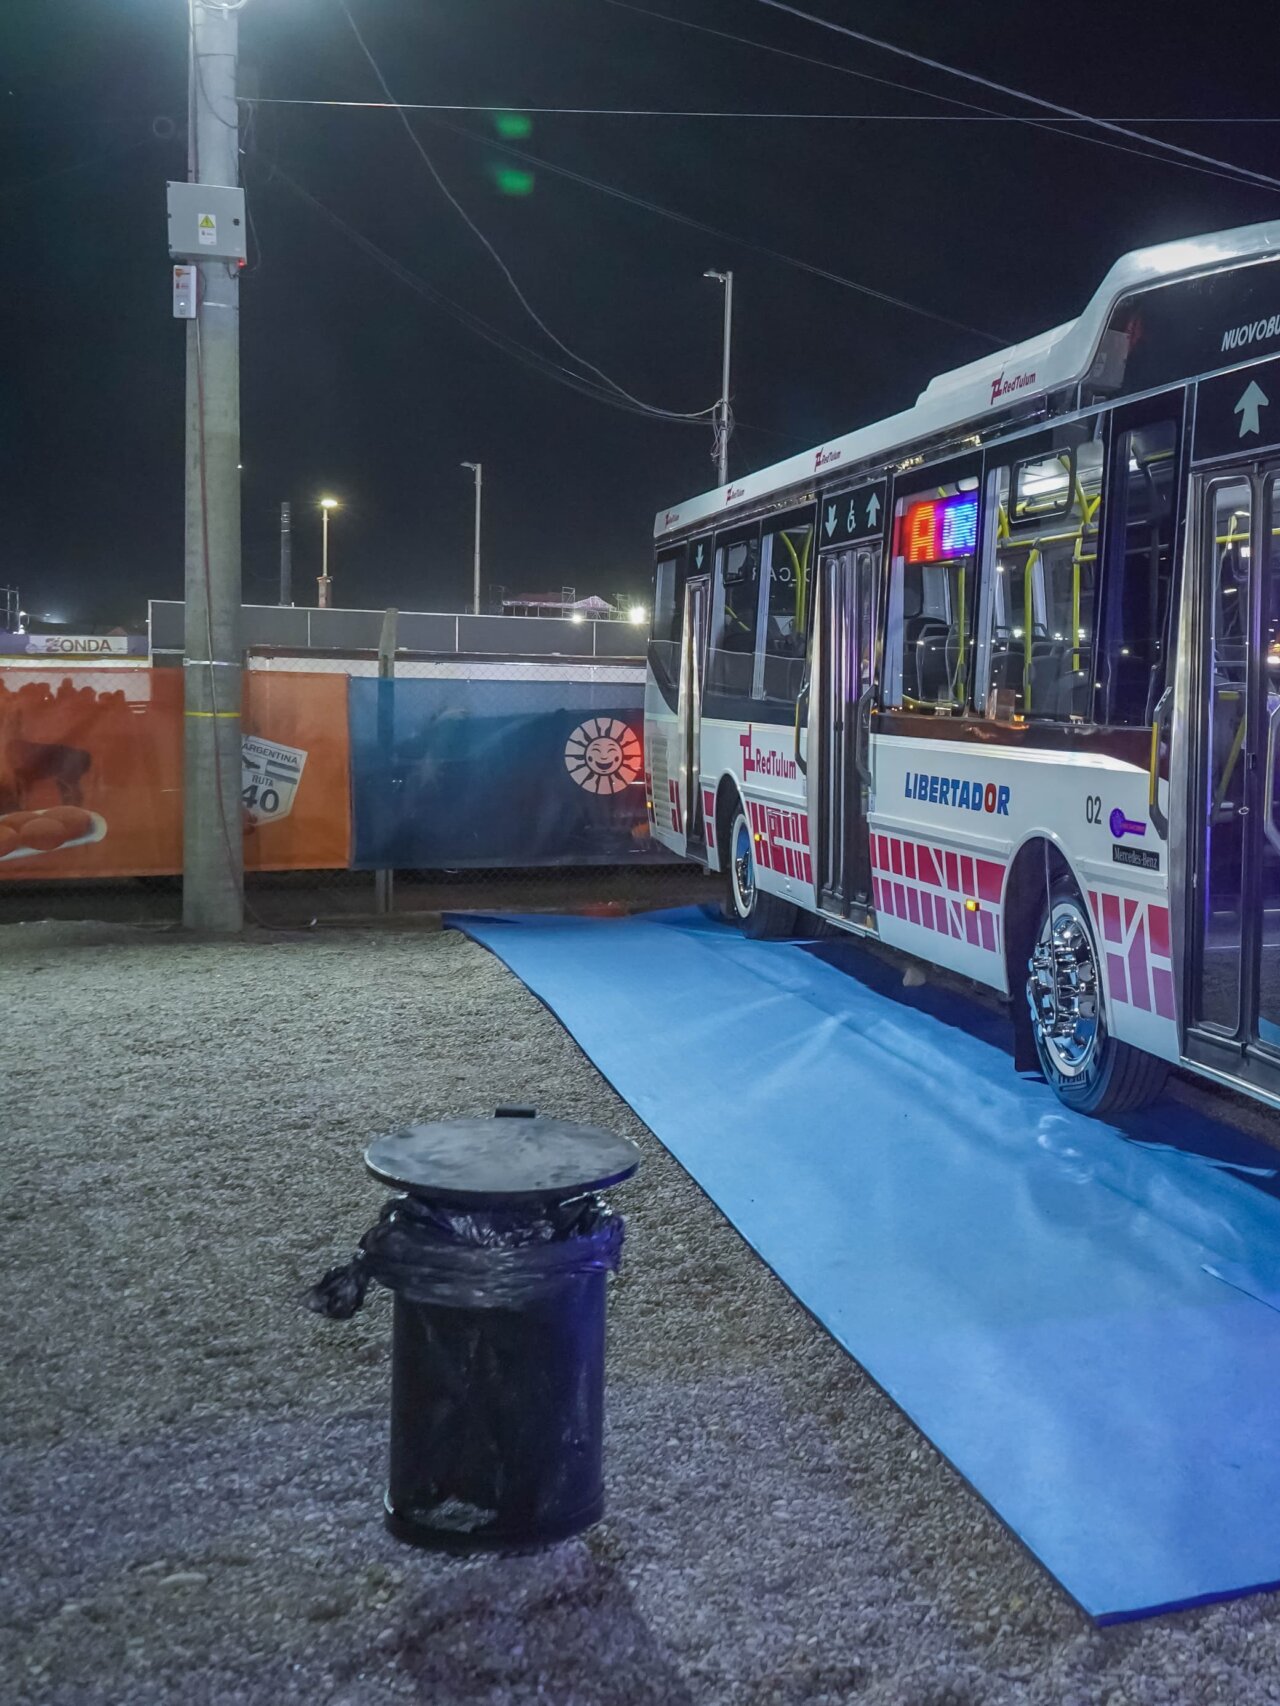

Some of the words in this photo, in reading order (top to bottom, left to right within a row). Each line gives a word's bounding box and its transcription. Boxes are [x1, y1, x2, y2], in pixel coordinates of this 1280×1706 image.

[1003, 373, 1036, 394] RedTulum
[908, 505, 935, 561] A
[45, 638, 112, 653] ZONDA
[241, 743, 299, 765] ARGENTINA
[756, 748, 797, 780] RedTulum
[251, 774, 274, 787] RUTA
[241, 784, 280, 813] 40
[904, 771, 1010, 816] LIBERTADOR
[1086, 795, 1102, 825] 02
[1114, 847, 1158, 868] Mercedes-Benz
